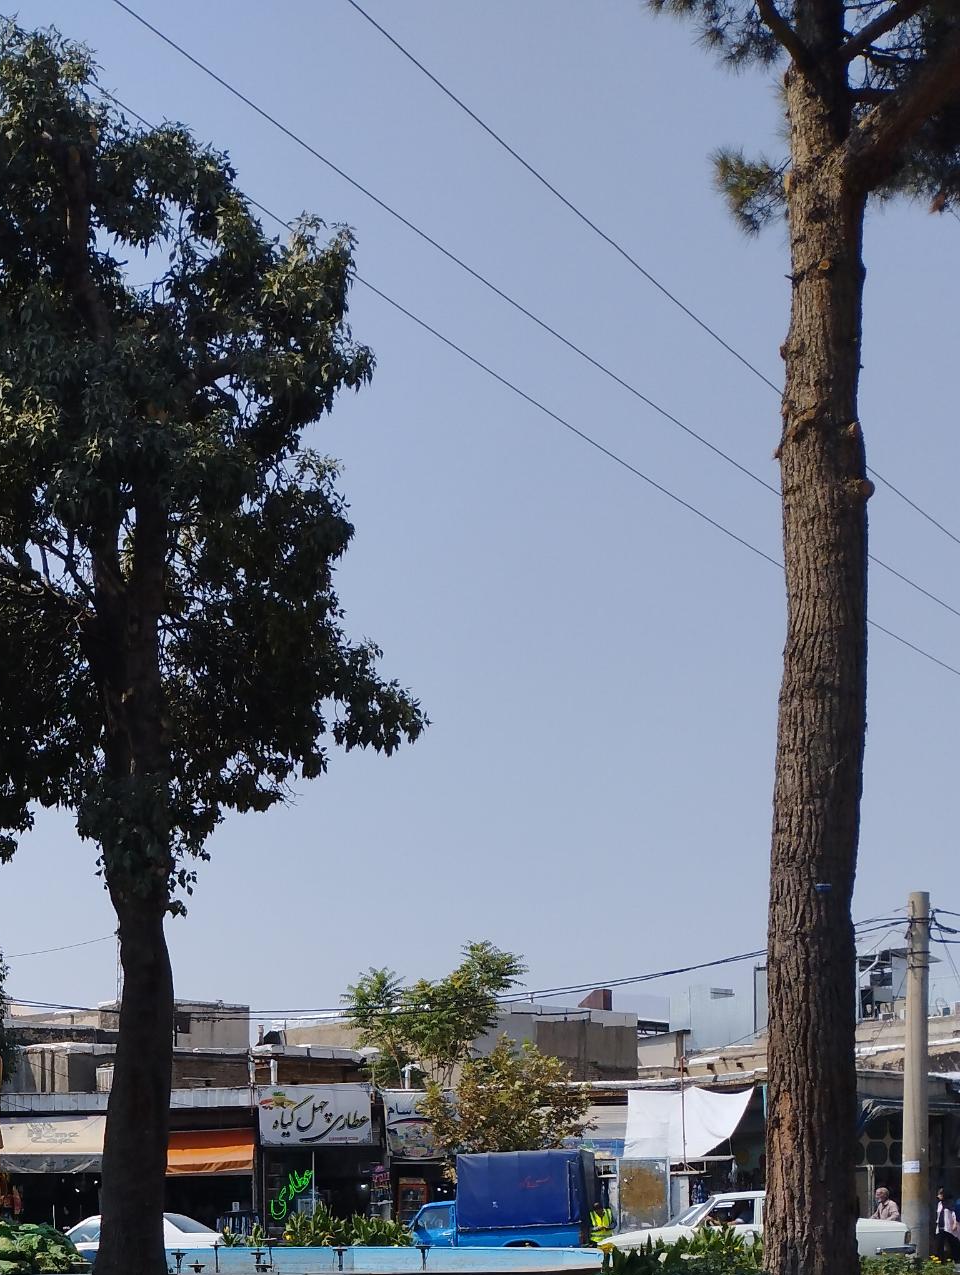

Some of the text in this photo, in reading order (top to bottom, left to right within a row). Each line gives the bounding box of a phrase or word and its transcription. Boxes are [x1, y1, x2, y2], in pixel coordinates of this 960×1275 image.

[272, 1095, 370, 1142] عطاری چهل گیاه
[271, 1169, 312, 1220] عطاری
